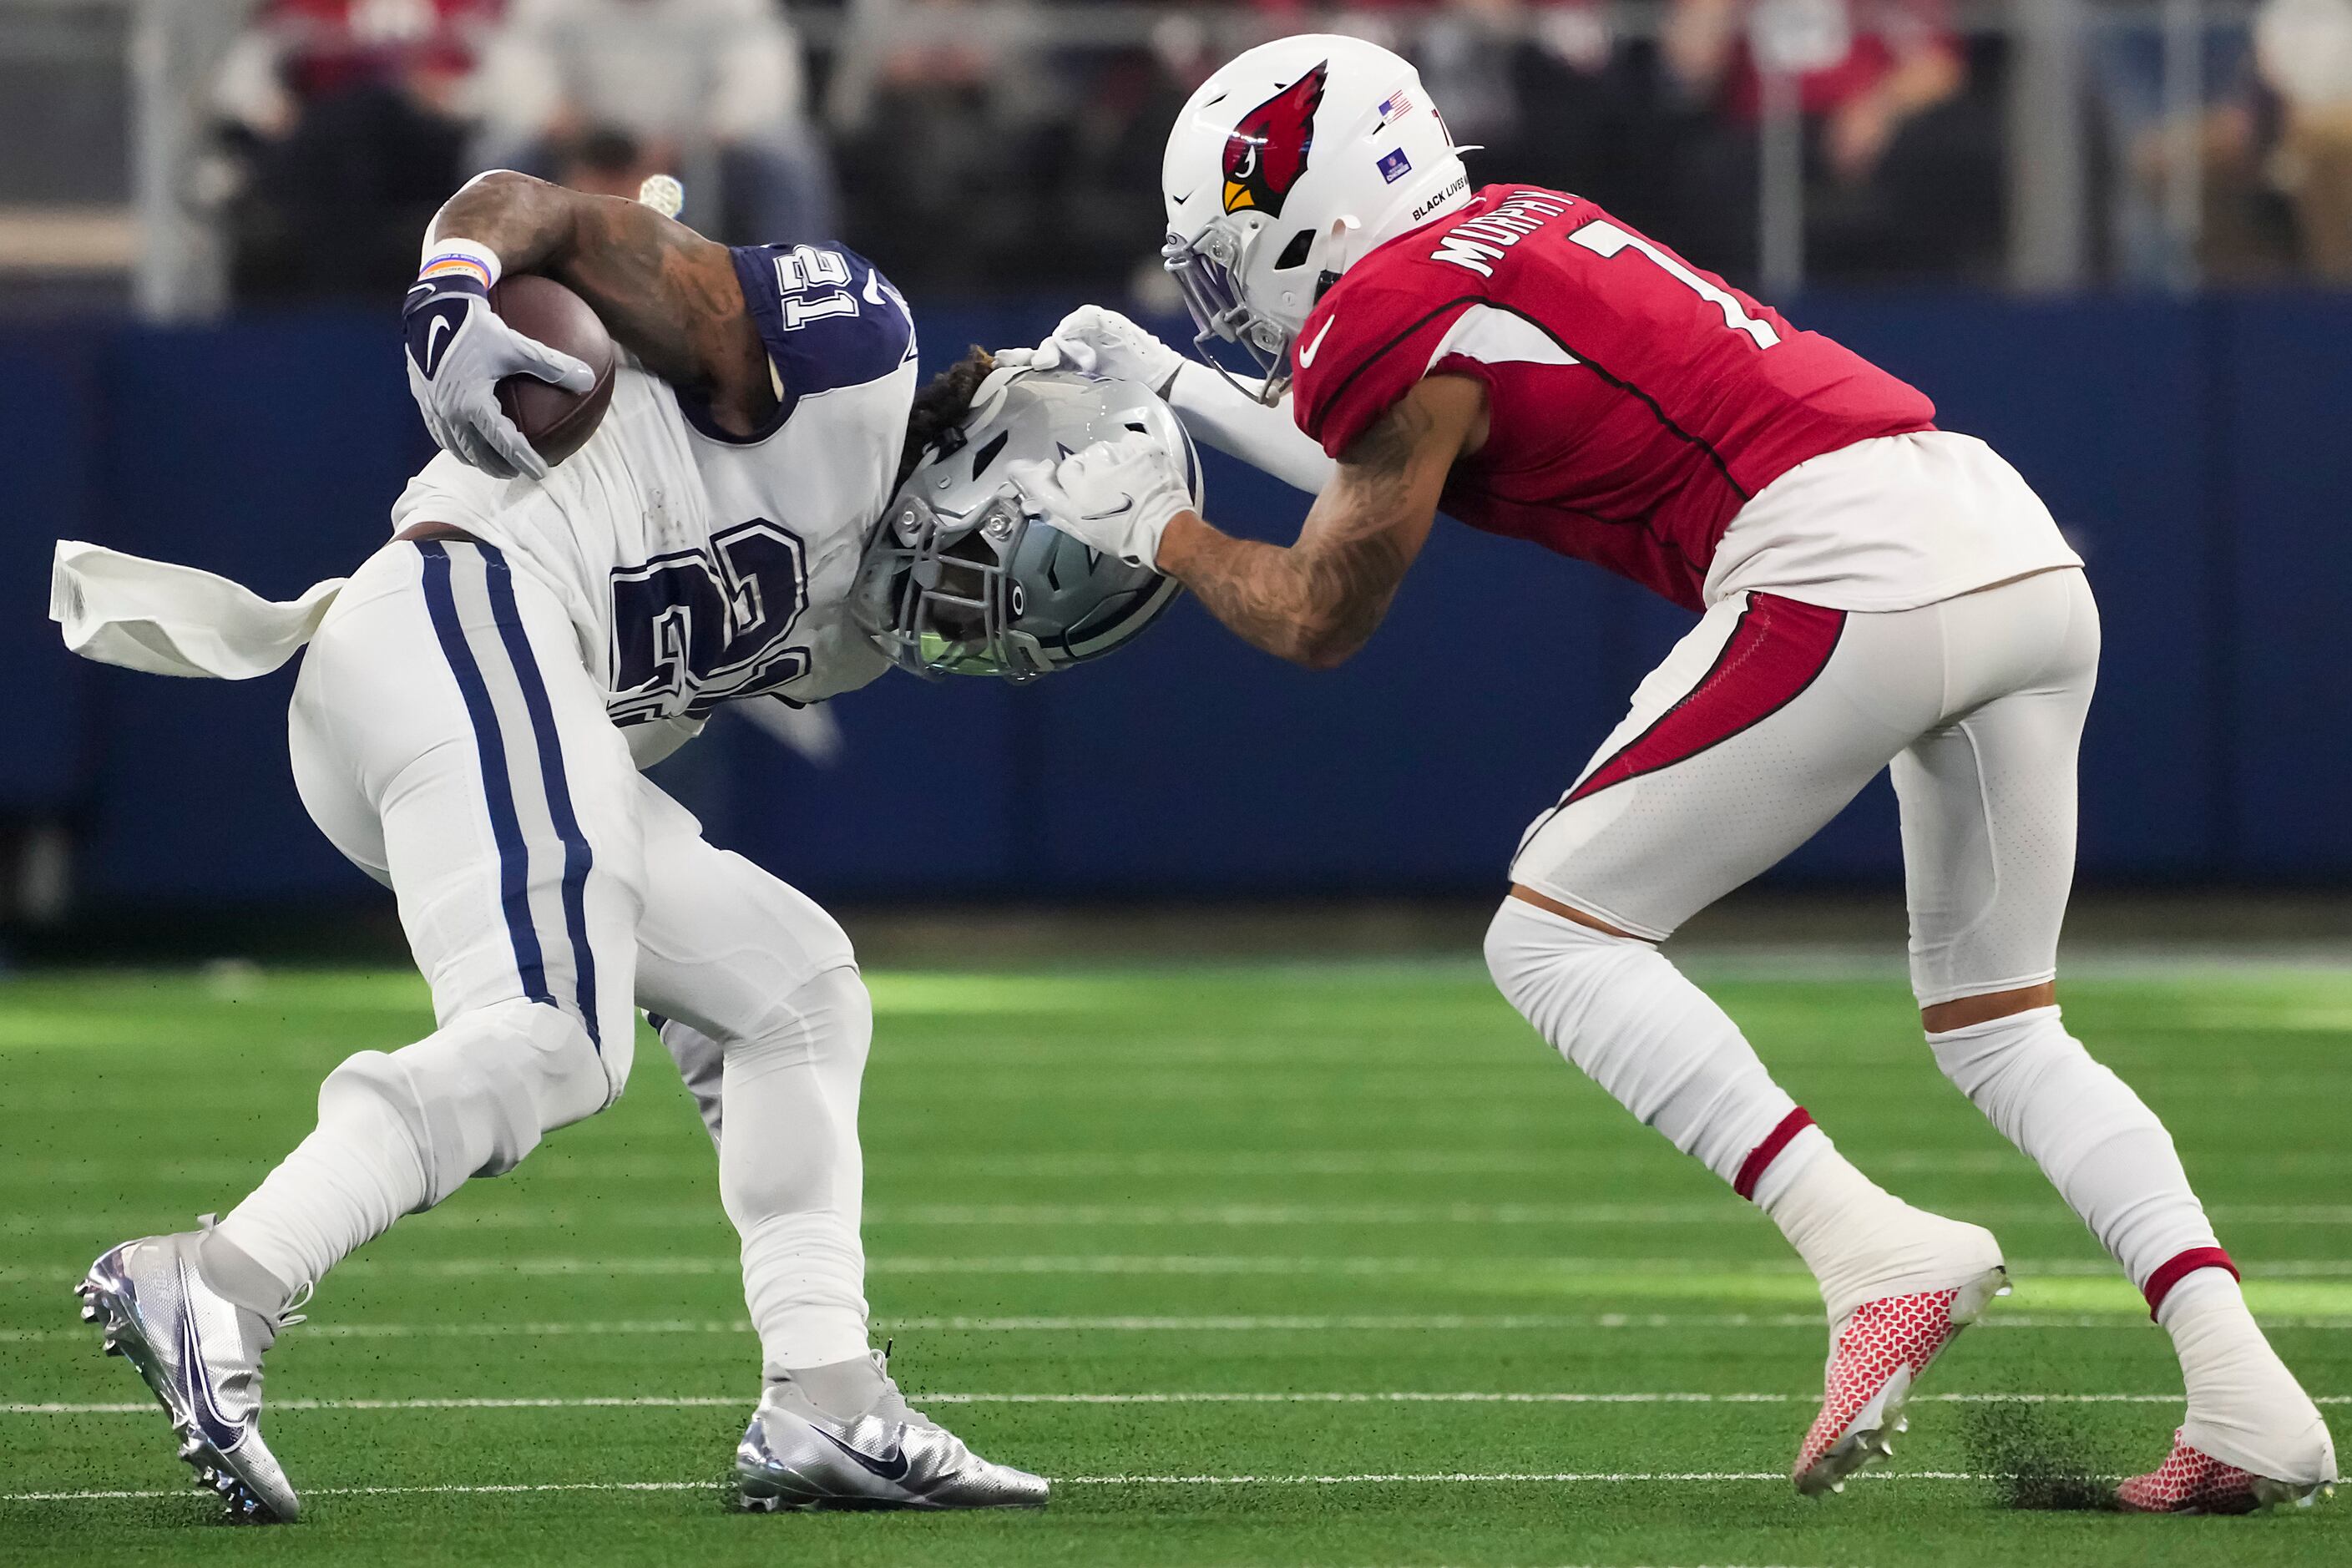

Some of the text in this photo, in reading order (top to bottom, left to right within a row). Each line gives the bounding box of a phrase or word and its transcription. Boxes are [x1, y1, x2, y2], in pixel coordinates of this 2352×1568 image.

[1413, 190, 1445, 221] BLACK
[1445, 177, 1464, 197] LIVES
[1430, 190, 1575, 278] MURPHY
[772, 244, 860, 331] 21
